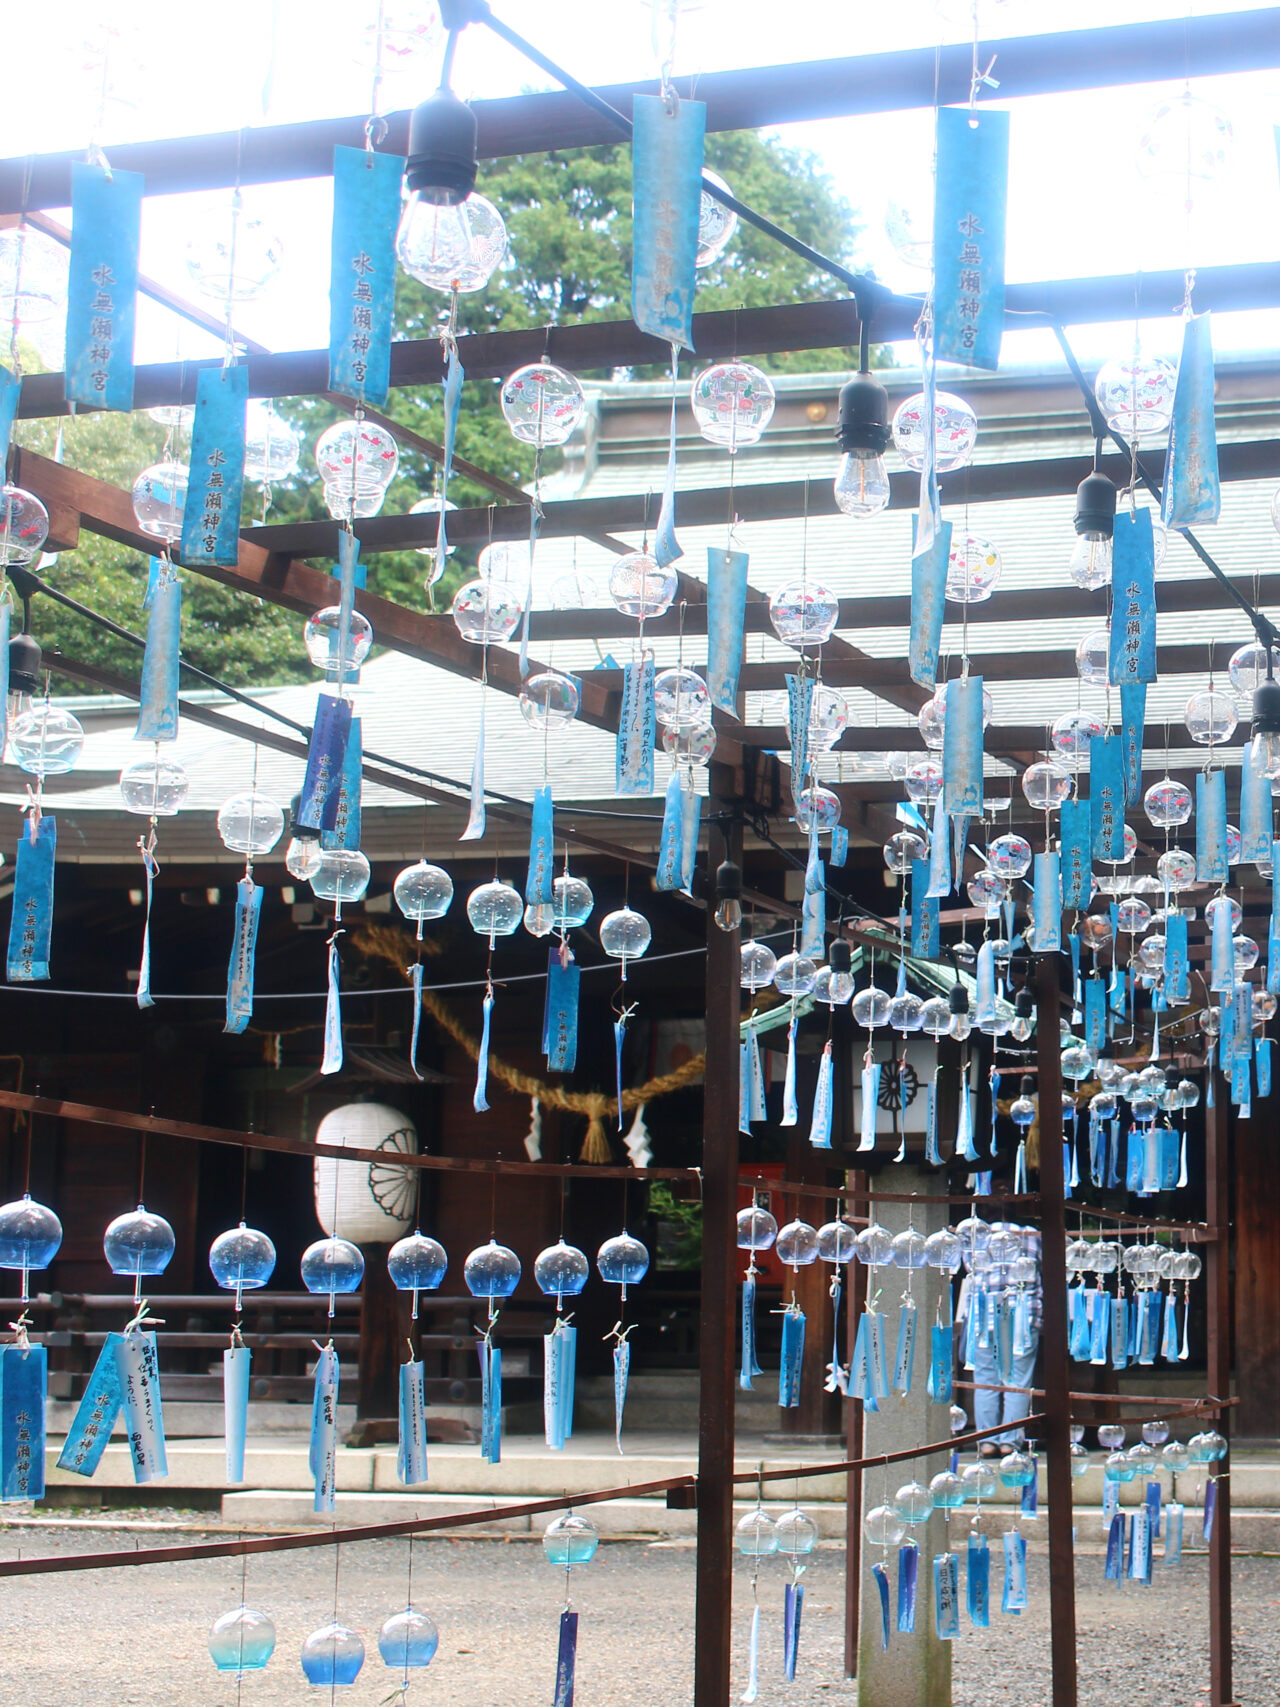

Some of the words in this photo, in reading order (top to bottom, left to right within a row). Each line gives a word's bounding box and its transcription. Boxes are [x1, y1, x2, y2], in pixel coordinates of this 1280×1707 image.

[958, 212, 984, 349] 水無瀬神宮
[201, 448, 227, 553] 水無瀬神宮
[1124, 581, 1143, 673] 水無瀬神宮
